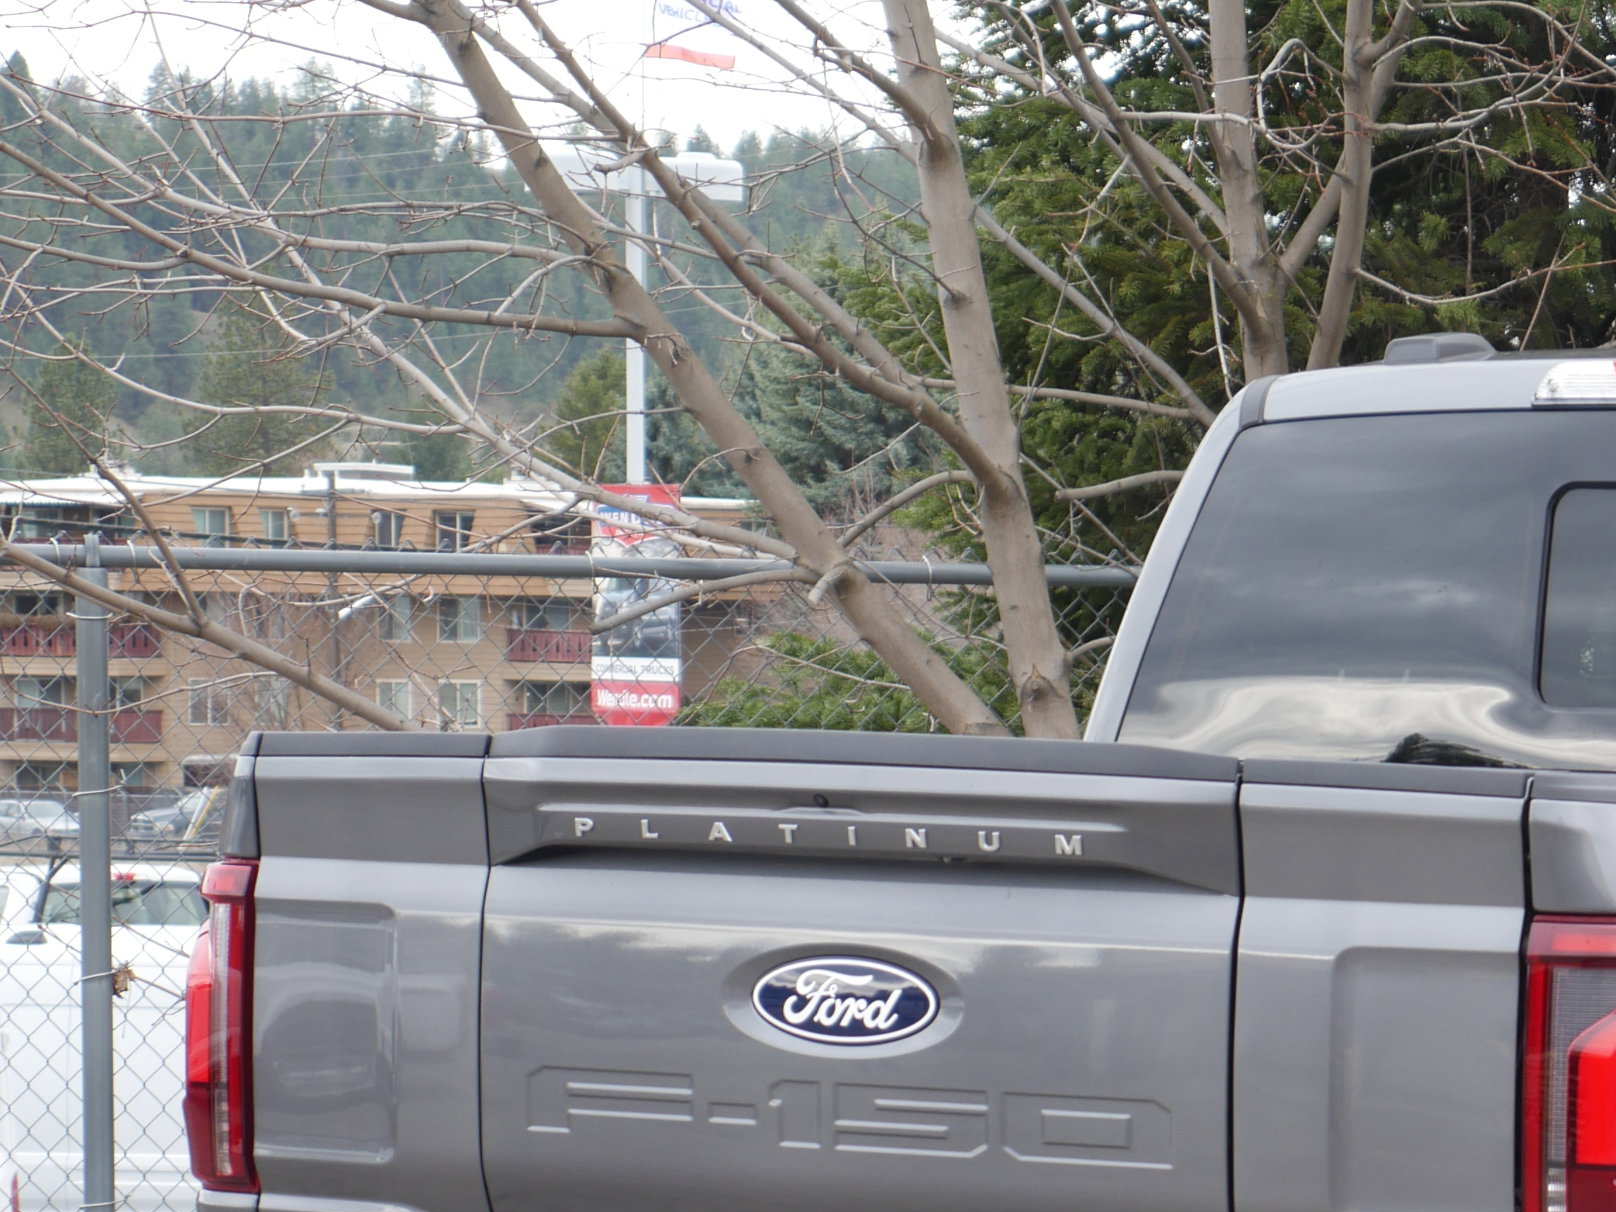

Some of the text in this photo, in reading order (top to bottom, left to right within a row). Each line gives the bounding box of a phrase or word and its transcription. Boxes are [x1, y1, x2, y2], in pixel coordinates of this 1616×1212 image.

[596, 688, 673, 709] Wendle.com
[572, 816, 1084, 857] PLATINUM
[782, 968, 904, 1032] Ford
[526, 1064, 1175, 1171] F-150
